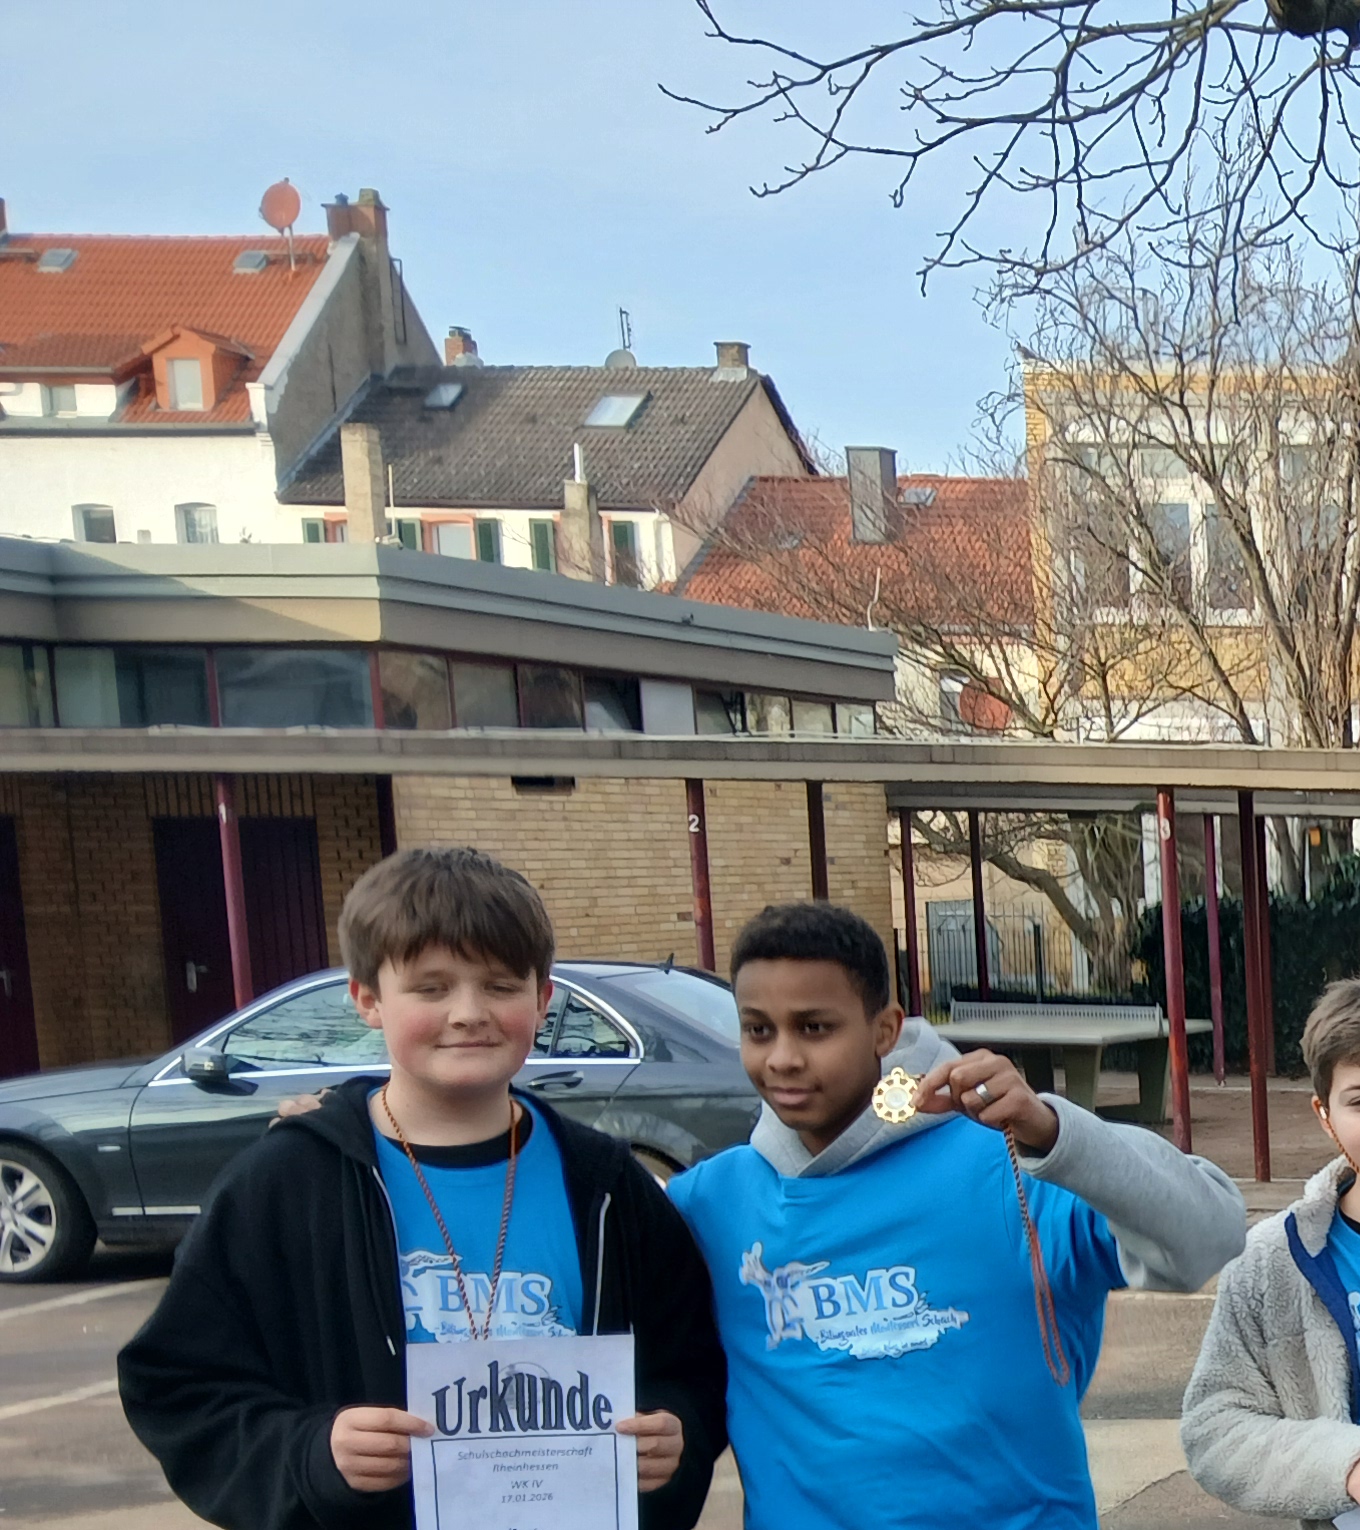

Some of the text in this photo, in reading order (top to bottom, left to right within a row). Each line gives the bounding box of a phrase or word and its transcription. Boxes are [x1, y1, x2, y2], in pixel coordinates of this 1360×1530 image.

[688, 814, 700, 832] 2
[436, 1275, 546, 1315] BMS
[808, 1271, 916, 1320] BMS
[432, 1360, 613, 1436] Urkunde
[457, 1447, 593, 1461] Schulschachmeisterschaft
[493, 1463, 559, 1473] Rheinhessen
[511, 1479, 544, 1489] WK IV
[501, 1493, 553, 1503] 17.01.2026
